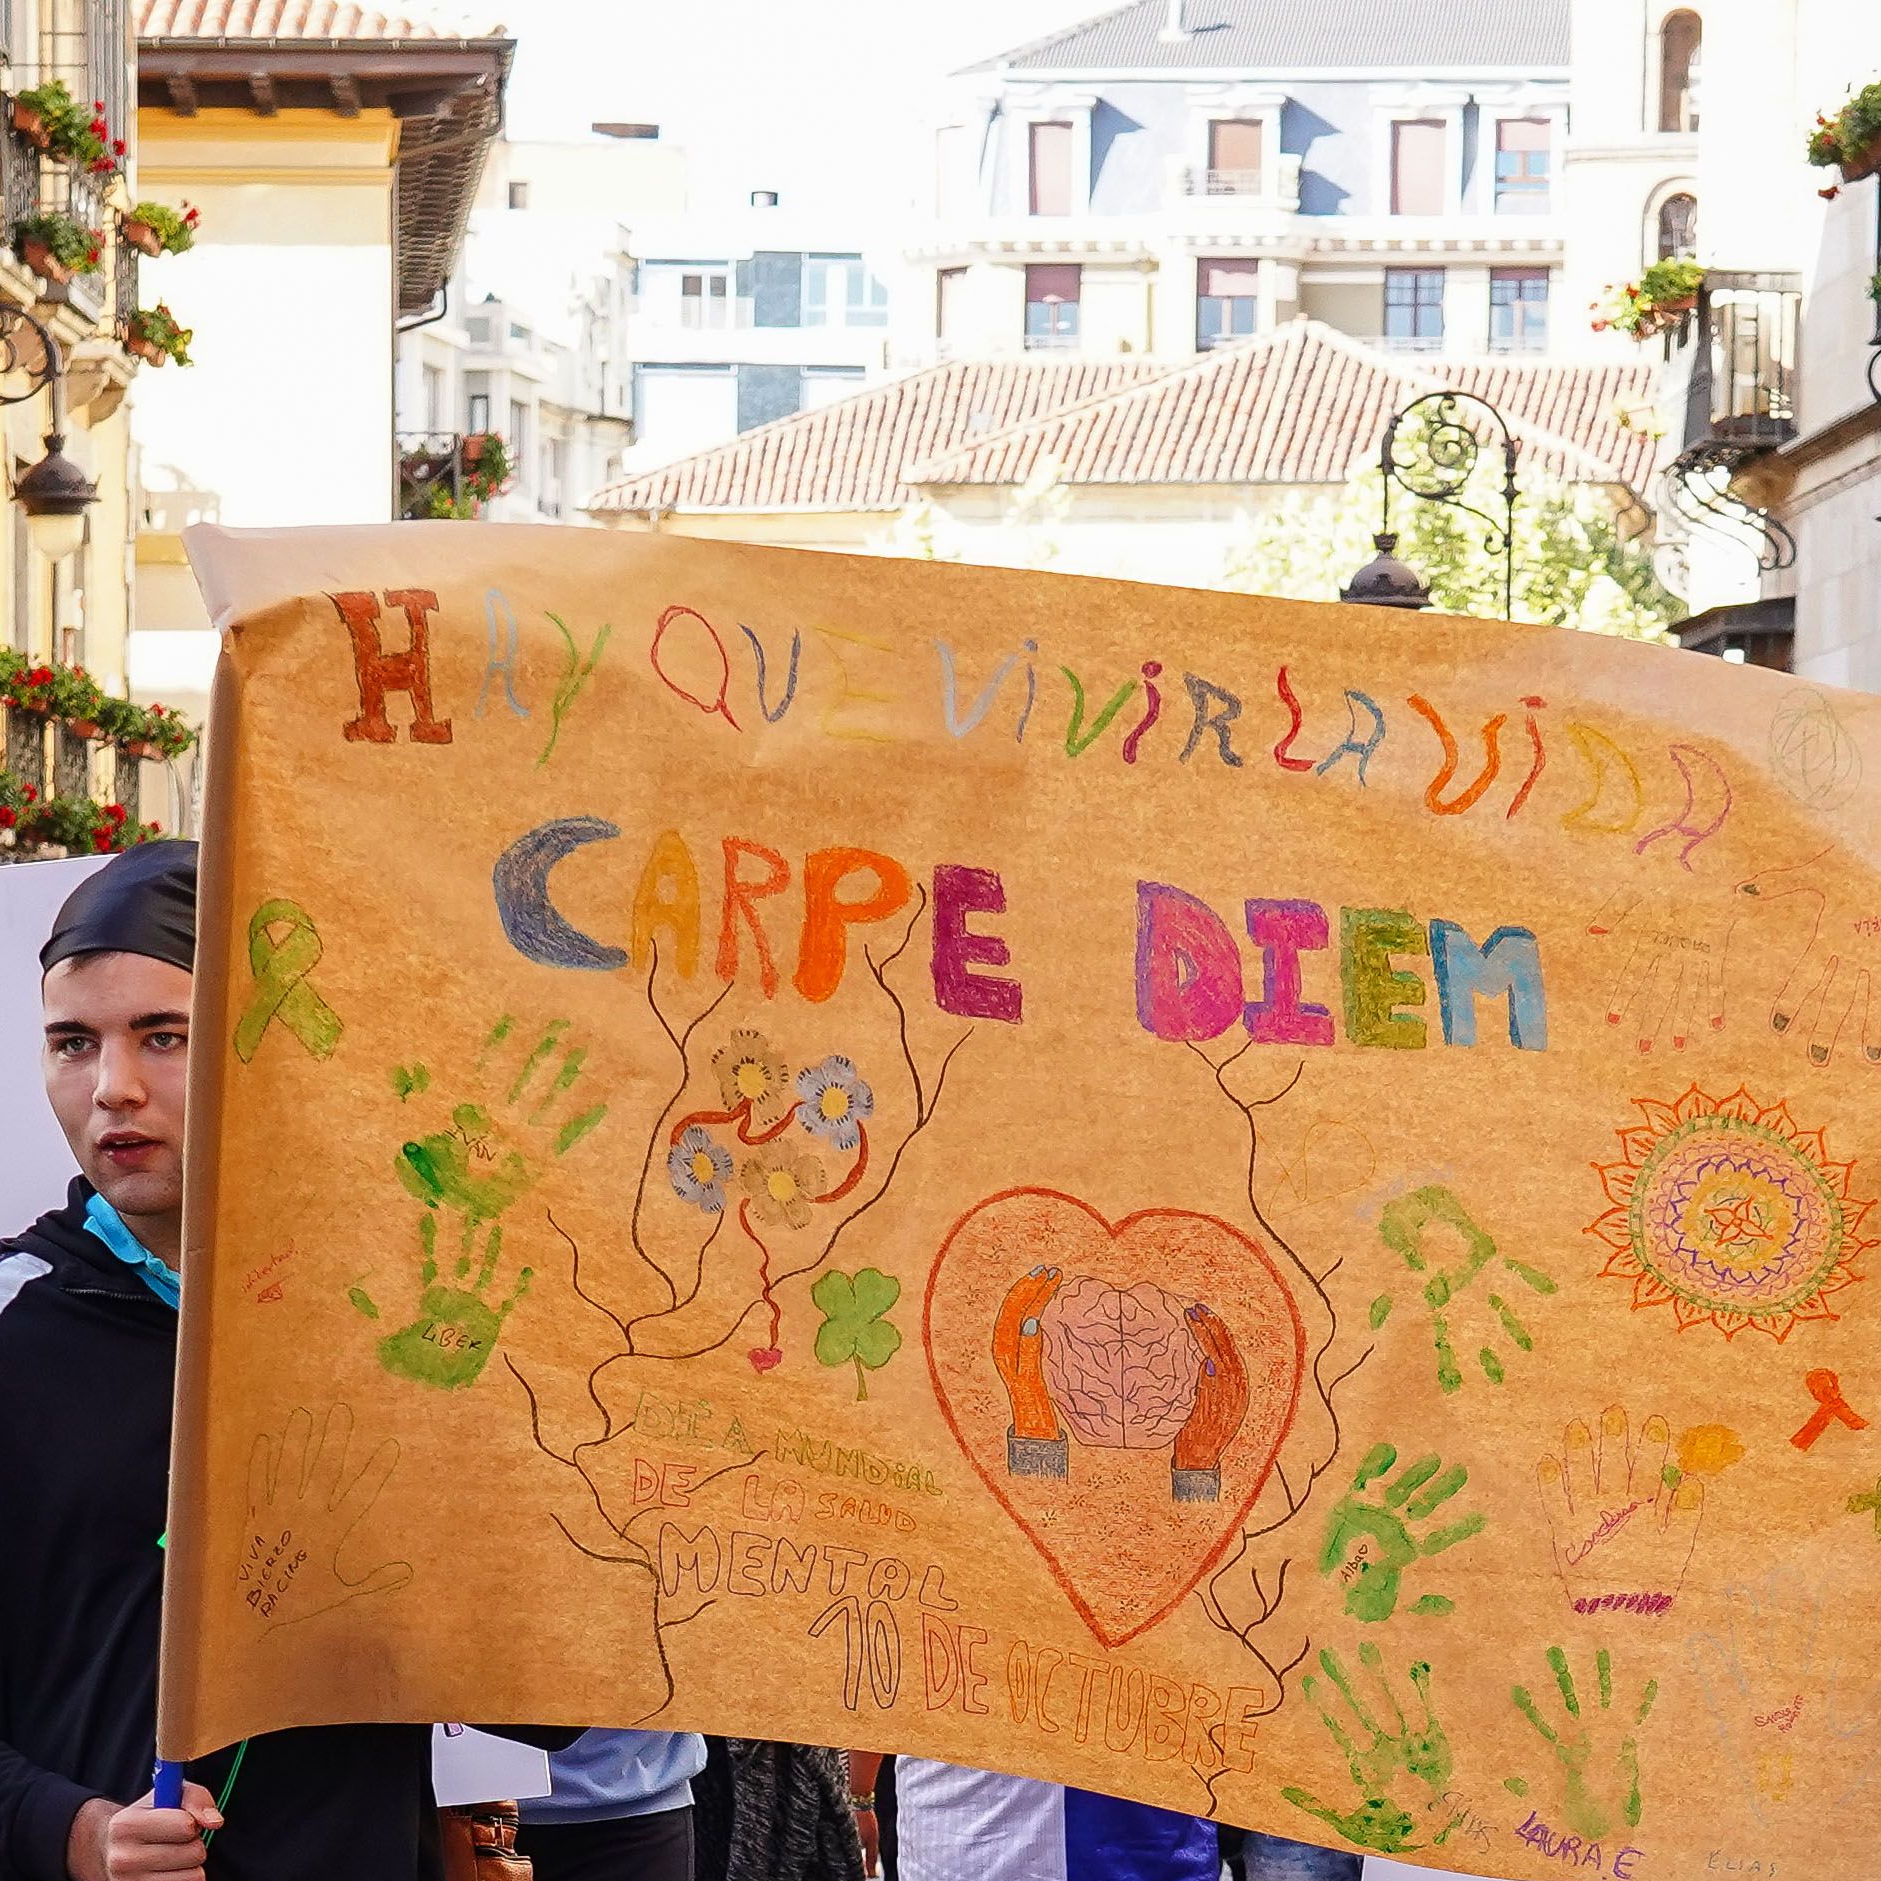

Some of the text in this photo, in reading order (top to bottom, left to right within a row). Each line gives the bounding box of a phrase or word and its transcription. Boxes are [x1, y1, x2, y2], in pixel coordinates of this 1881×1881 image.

[323, 588, 612, 770] HAY
[650, 604, 899, 743] QUE
[1277, 665, 1387, 787] LA
[493, 814, 1546, 1050] CARPE DIEM
[633, 1458, 917, 1532] DE LA SALUD
[659, 1521, 959, 1612] MENTAL
[807, 1595, 1265, 1774] 10 DE OCTUBRE
